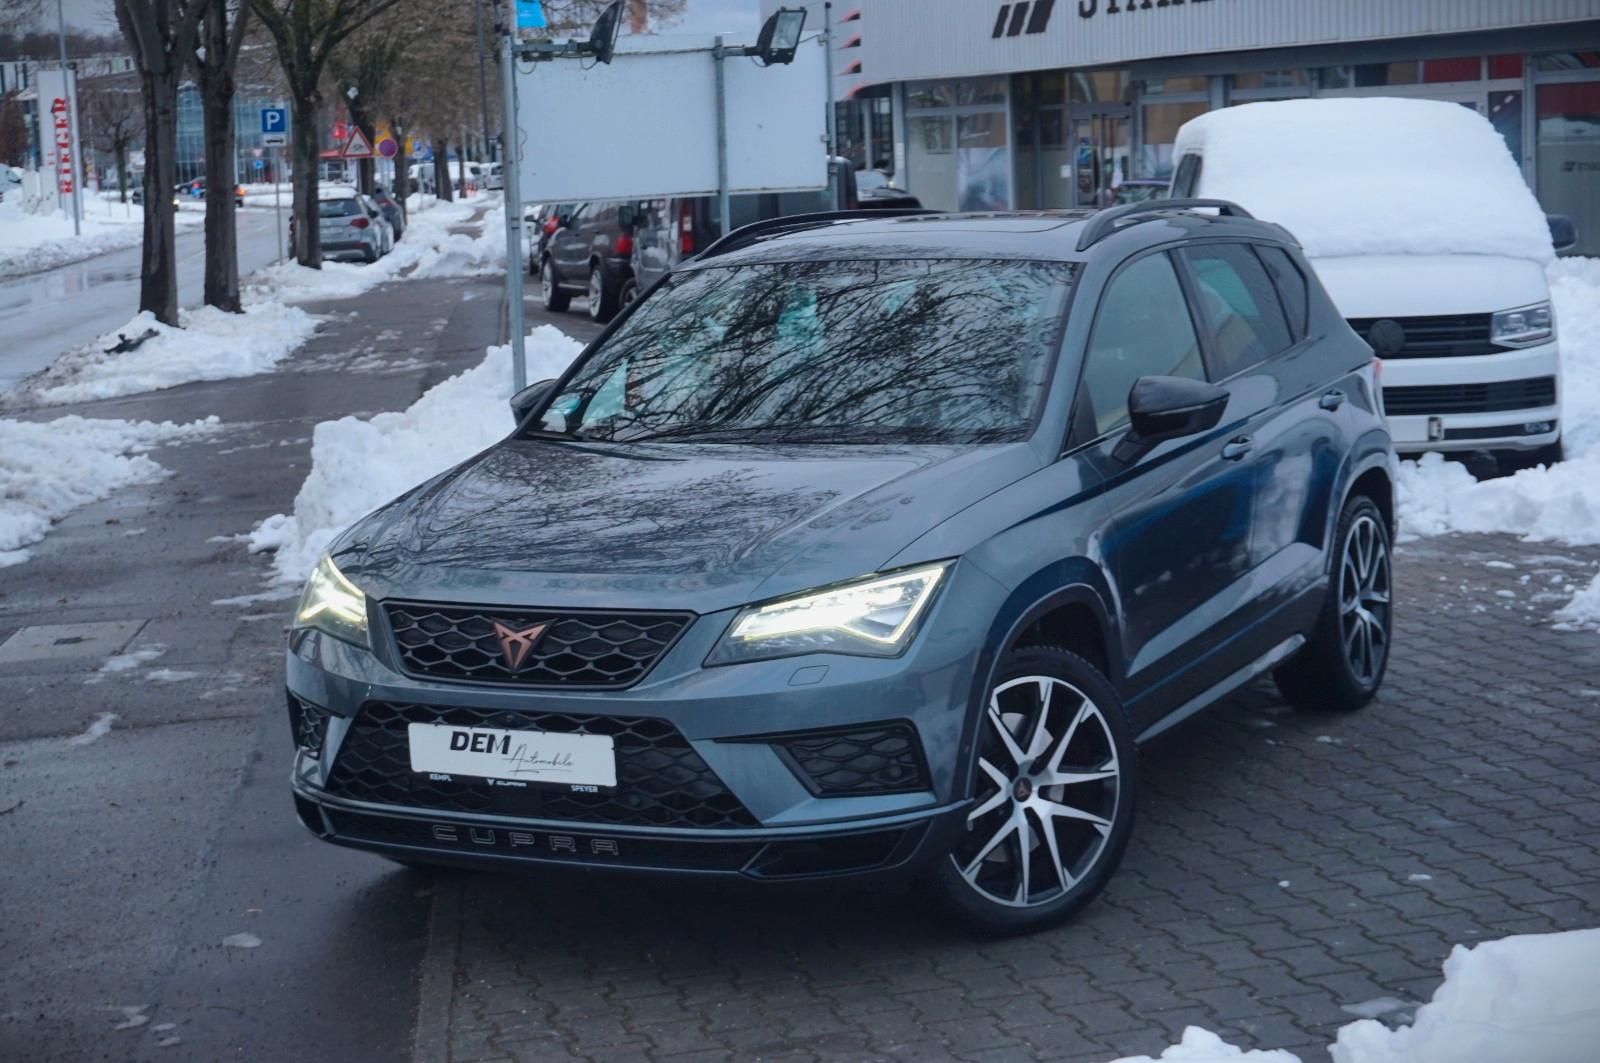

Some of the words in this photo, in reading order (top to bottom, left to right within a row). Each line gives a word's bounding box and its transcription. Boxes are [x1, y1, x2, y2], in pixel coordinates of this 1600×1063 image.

[266, 111, 281, 130] P
[449, 730, 512, 755] DEM
[570, 784, 598, 793] SPEYER
[432, 824, 619, 856] CUPRA
